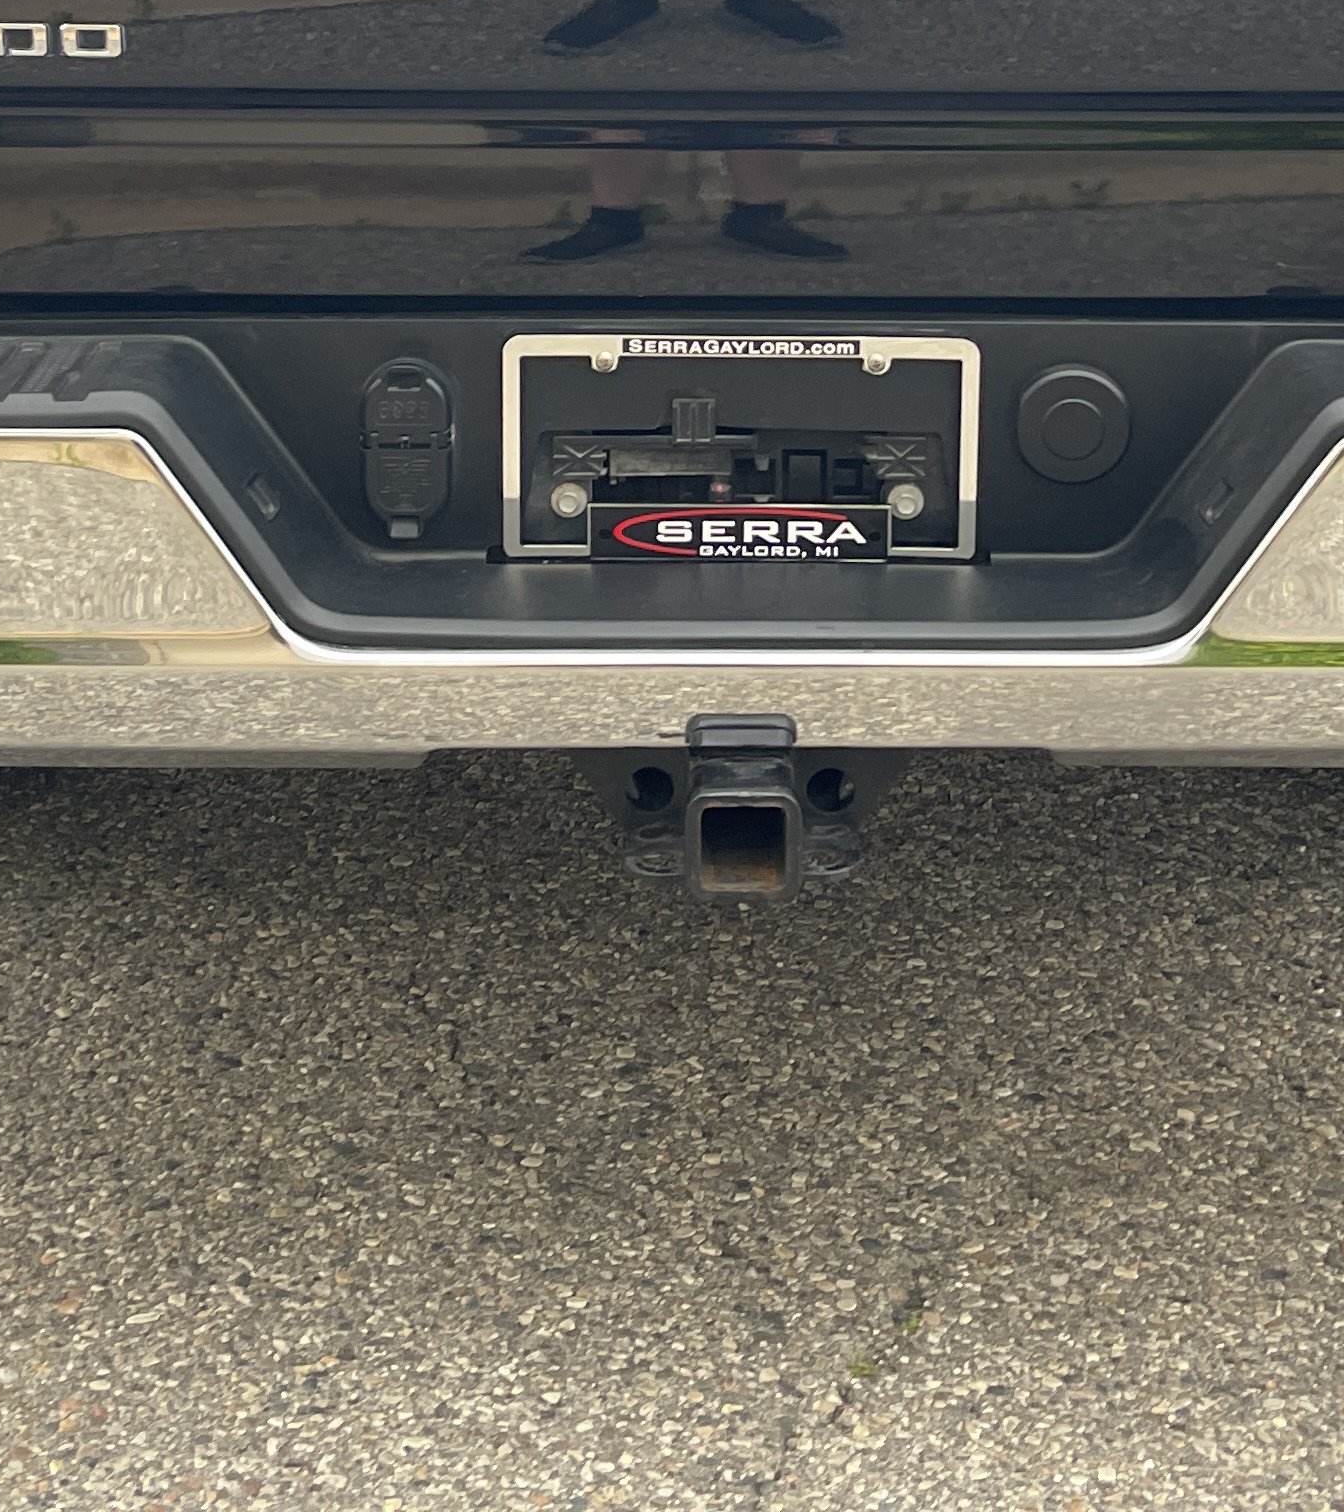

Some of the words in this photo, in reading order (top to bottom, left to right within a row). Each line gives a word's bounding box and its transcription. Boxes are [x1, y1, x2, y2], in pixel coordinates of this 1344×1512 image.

[655, 519, 867, 545] SERRA
[699, 544, 808, 559] GAYLORD,
[815, 545, 840, 558] MI
